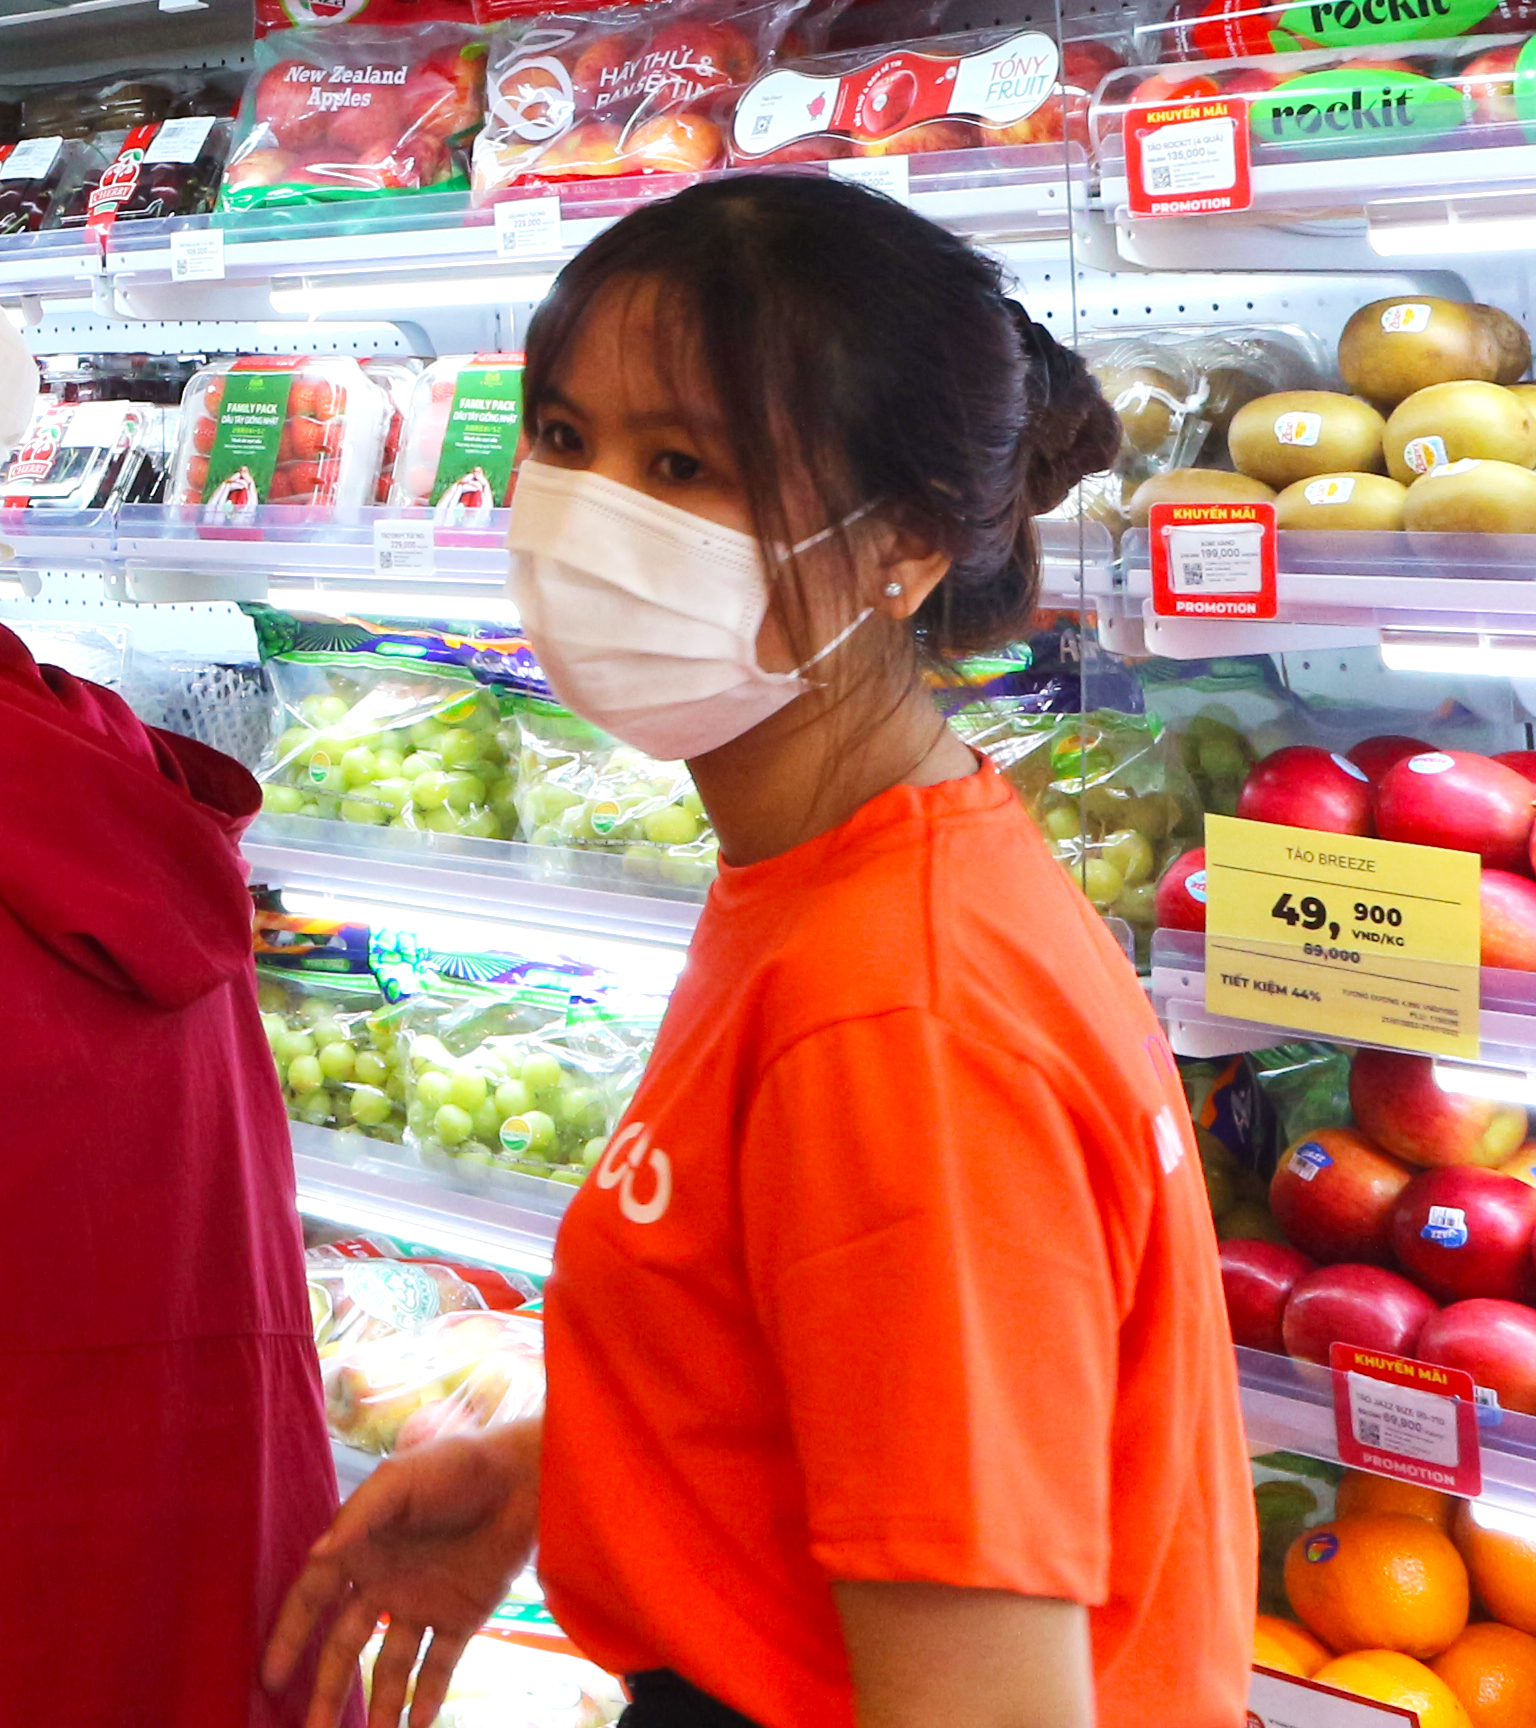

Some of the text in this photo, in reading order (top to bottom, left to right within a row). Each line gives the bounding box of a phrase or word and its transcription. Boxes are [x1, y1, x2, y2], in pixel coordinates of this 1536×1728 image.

[284, 65, 409, 85] New Zealand
[985, 72, 1047, 103] FRUIT
[307, 88, 371, 112] Apples
[1146, 102, 1228, 123] KHUYẾN MÃI
[1271, 87, 1416, 137] rockit
[91, 185, 132, 204] CHERRY
[1151, 197, 1231, 213] PROMOTION
[9, 459, 52, 483] CHERRY
[1173, 505, 1257, 520] KHUYẾN MÃI
[1175, 601, 1257, 613] PROMOTION
[1318, 852, 1376, 873] BREEZE
[1271, 892, 1403, 941] 49, 900
[1352, 928, 1405, 947] VND/KG
[1354, 1352, 1415, 1376] KHUYẾN
[1362, 1452, 1456, 1486] PROMOTION
